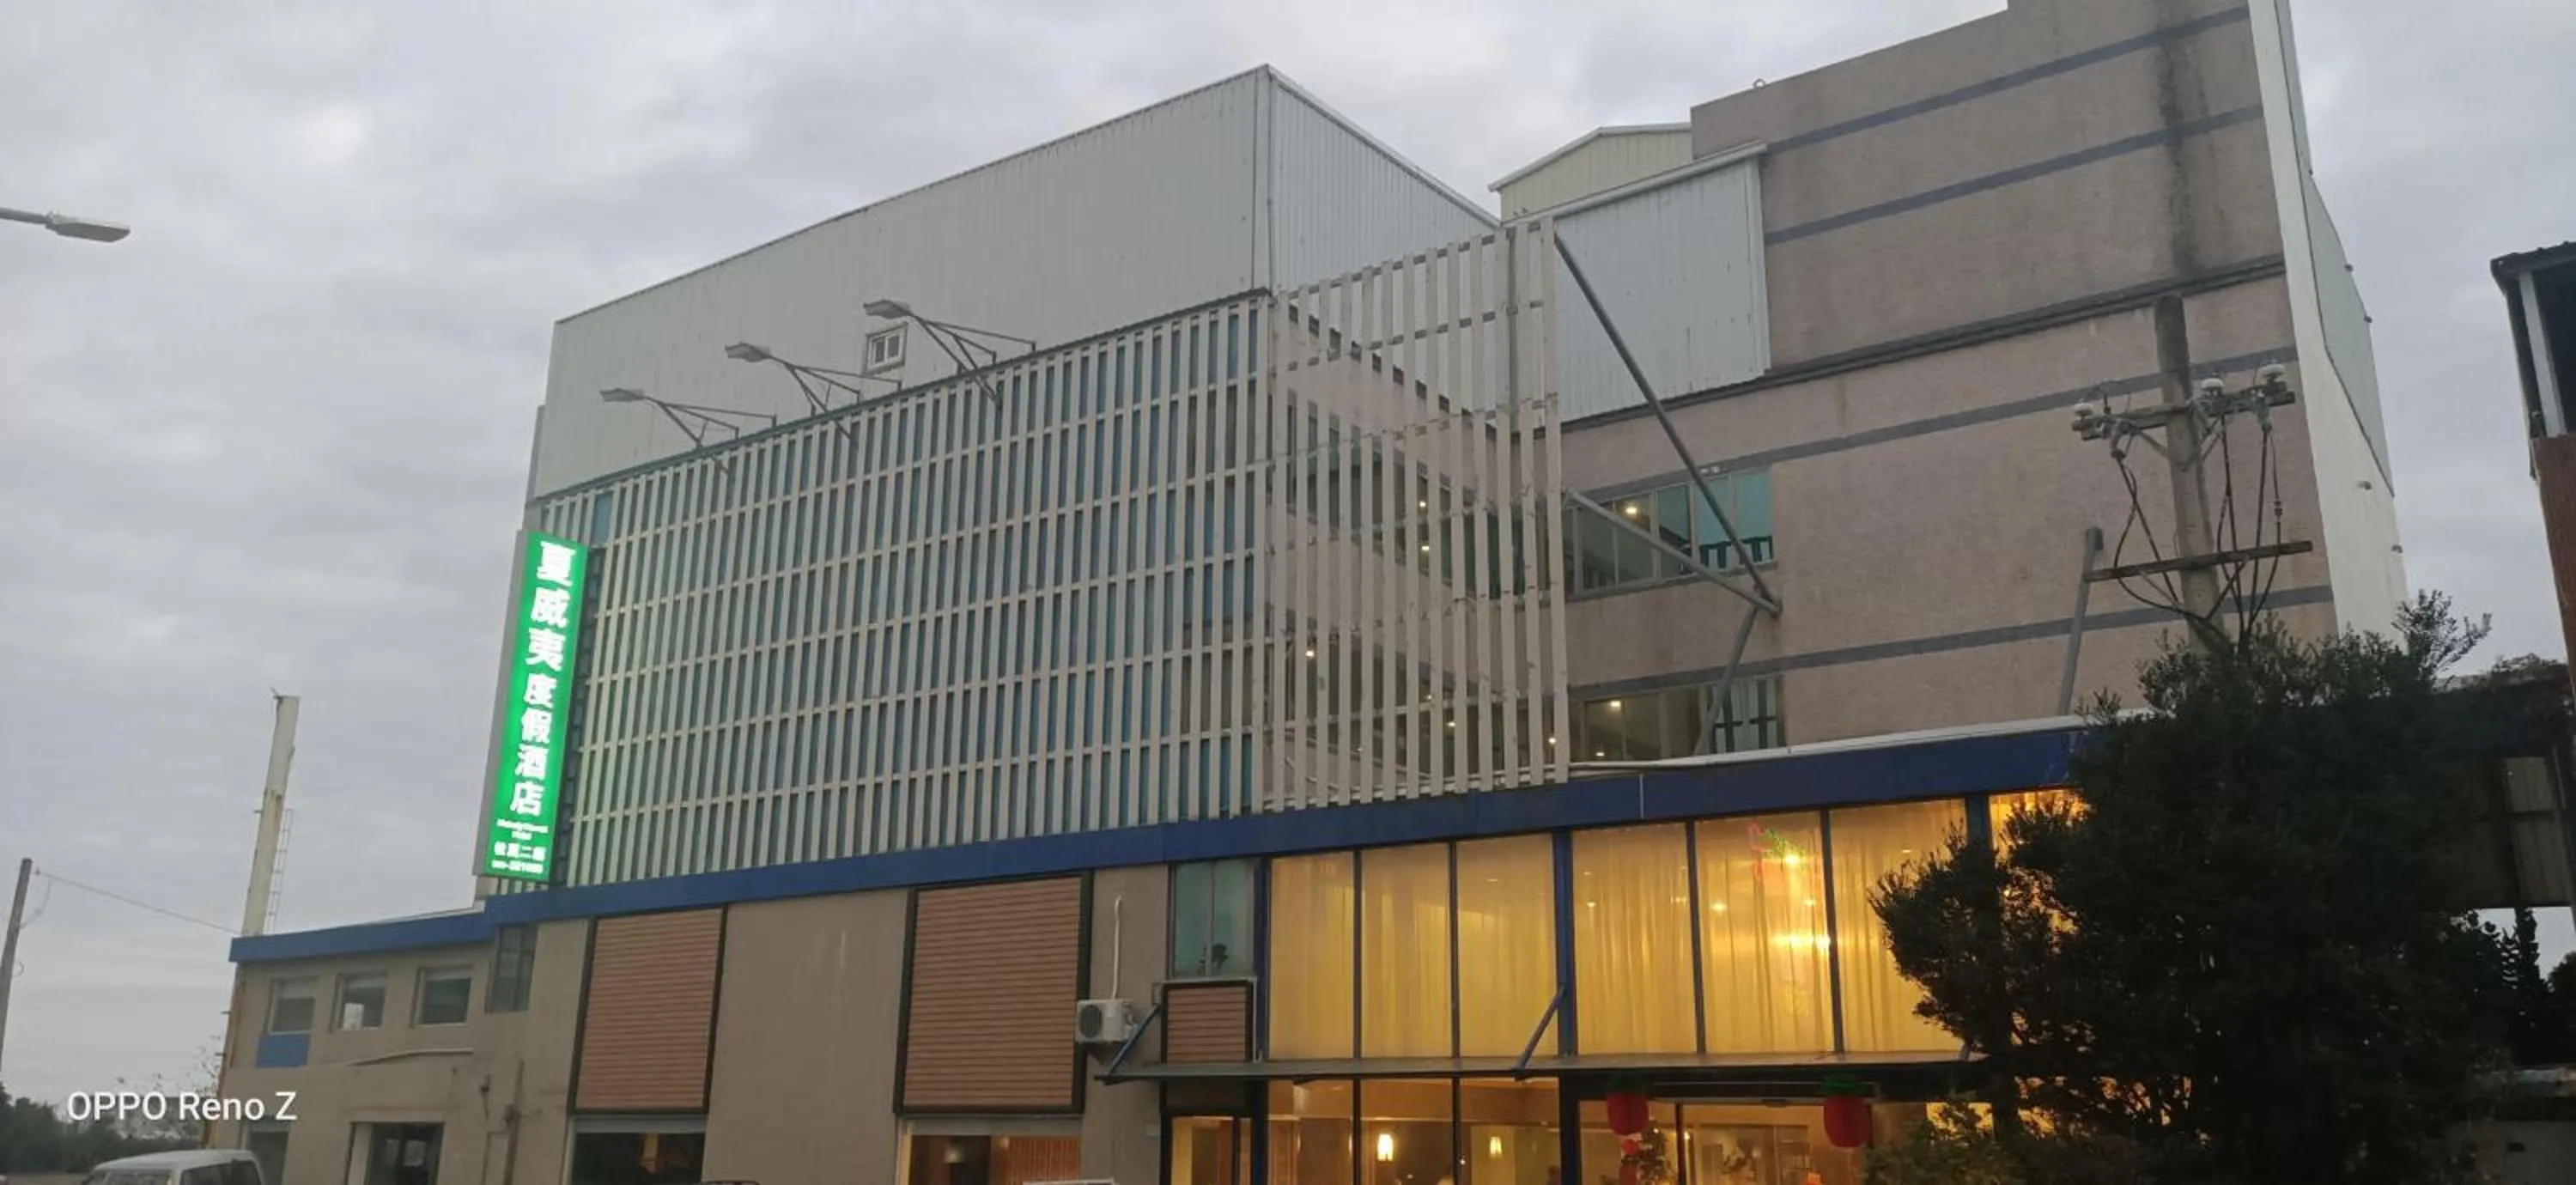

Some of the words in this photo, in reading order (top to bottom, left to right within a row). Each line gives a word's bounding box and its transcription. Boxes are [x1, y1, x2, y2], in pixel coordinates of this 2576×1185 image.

[510, 540, 576, 817] 夏威夷度假酒店
